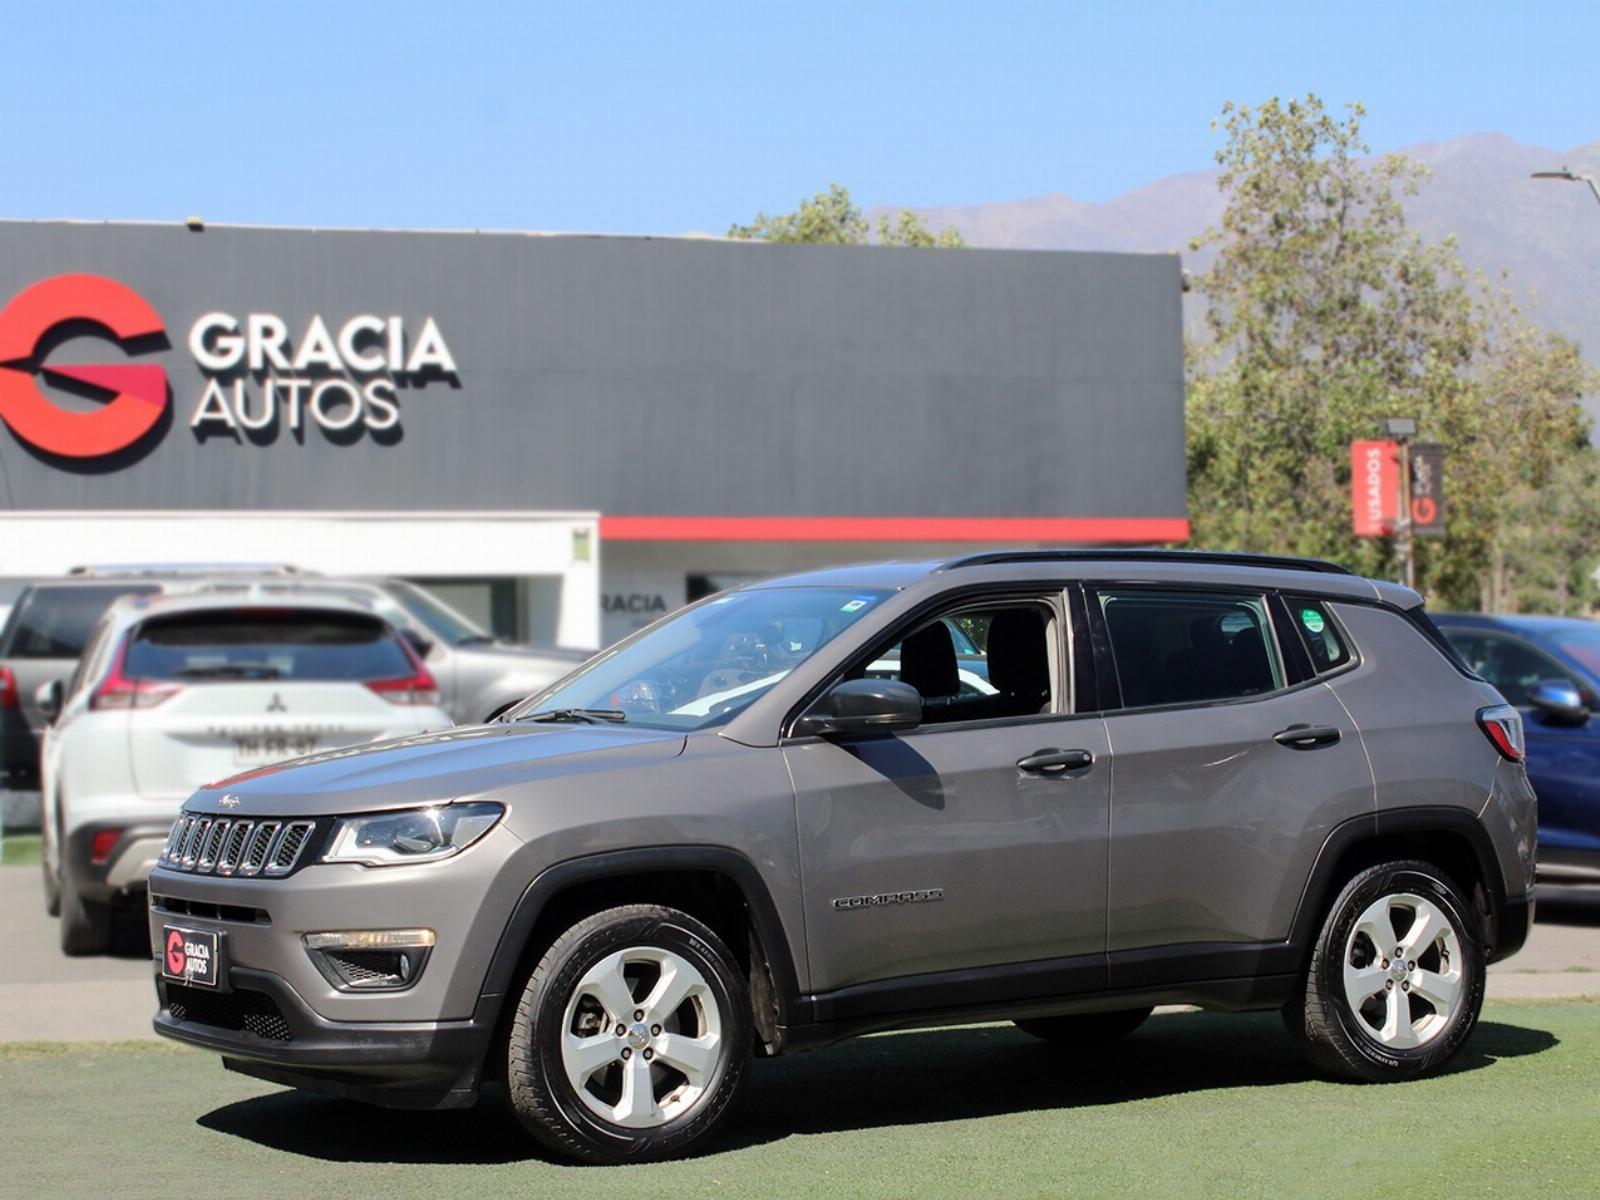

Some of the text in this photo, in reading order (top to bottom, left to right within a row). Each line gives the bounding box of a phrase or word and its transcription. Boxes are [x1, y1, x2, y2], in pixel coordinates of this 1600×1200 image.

[189, 313, 457, 371] GRACIA
[190, 378, 400, 430] AUTOS
[1366, 448, 1382, 520] USADOS
[832, 887, 945, 911] COMPASS
[184, 942, 210, 960] GRACIA
[186, 957, 208, 975] AUTOS
